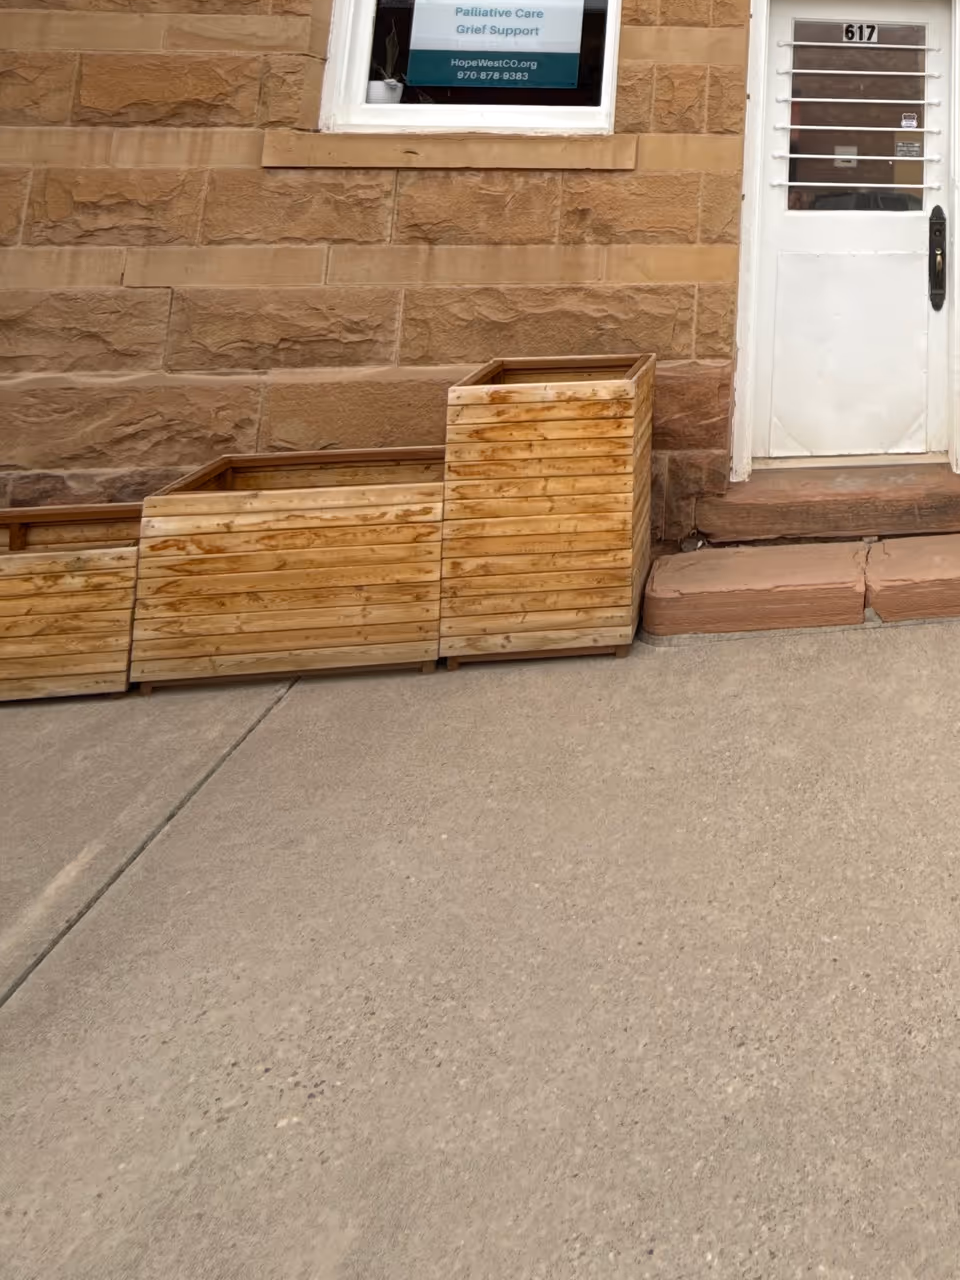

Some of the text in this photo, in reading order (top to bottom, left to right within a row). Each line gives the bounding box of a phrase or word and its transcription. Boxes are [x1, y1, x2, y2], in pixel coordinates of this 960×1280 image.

[455, 6, 545, 19] Palliative Care
[456, 24, 540, 37] Grief Support
[844, 24, 876, 42] 617
[450, 58, 538, 70] HopeWestCO.org
[457, 70, 529, 81] 970-878-9383
